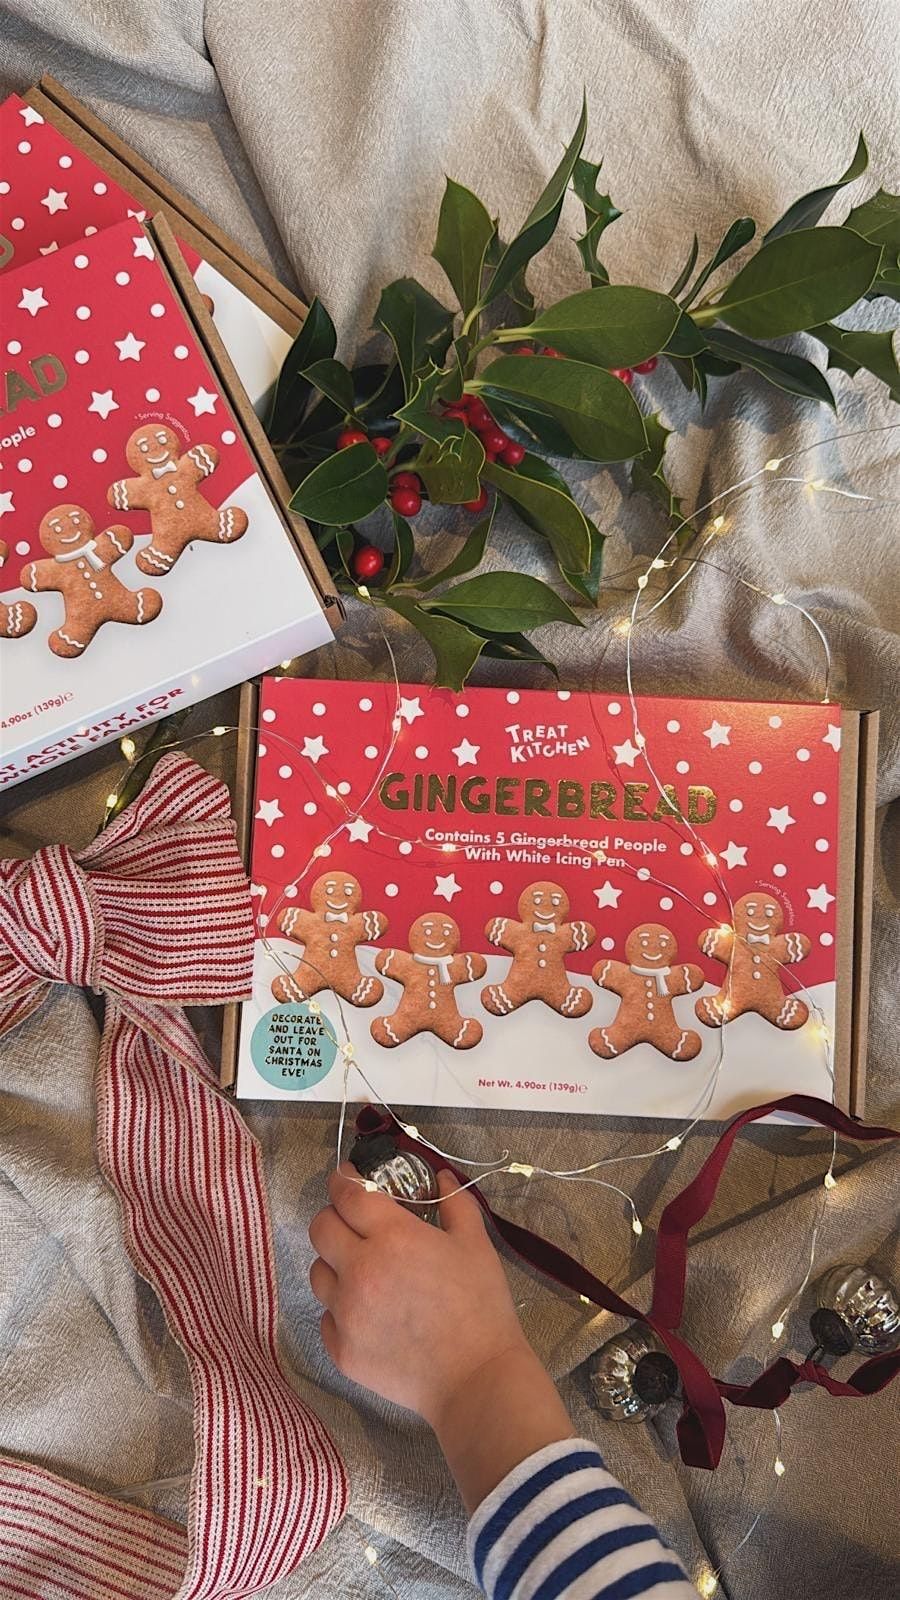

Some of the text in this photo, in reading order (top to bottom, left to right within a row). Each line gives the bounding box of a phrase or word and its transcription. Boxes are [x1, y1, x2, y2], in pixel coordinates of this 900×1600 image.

[1, 711, 33, 729] 4.90oz
[27, 688, 185, 764] ACTIVITY FOR
[89, 702, 169, 743] FAMILY
[504, 724, 568, 743] TREAT
[510, 736, 591, 763] KITCHEN
[379, 772, 718, 826] GINGERBREAD
[425, 828, 667, 855] Contains 5 Gingerbread People
[465, 847, 625, 869] With White Icing Pen
[271, 1013, 322, 1025] DECORATE
[268, 1024, 325, 1036] AND LEAVE
[273, 1035, 317, 1046] OUT FOR
[269, 1045, 321, 1057] SANTA ON
[265, 1056, 323, 1068] CHRISTMAS
[281, 1068, 306, 1078] EVE!
[478, 1079, 495, 1088] Net
[498, 1080, 513, 1089] Wt.
[515, 1081, 546, 1090] 4.90oz
